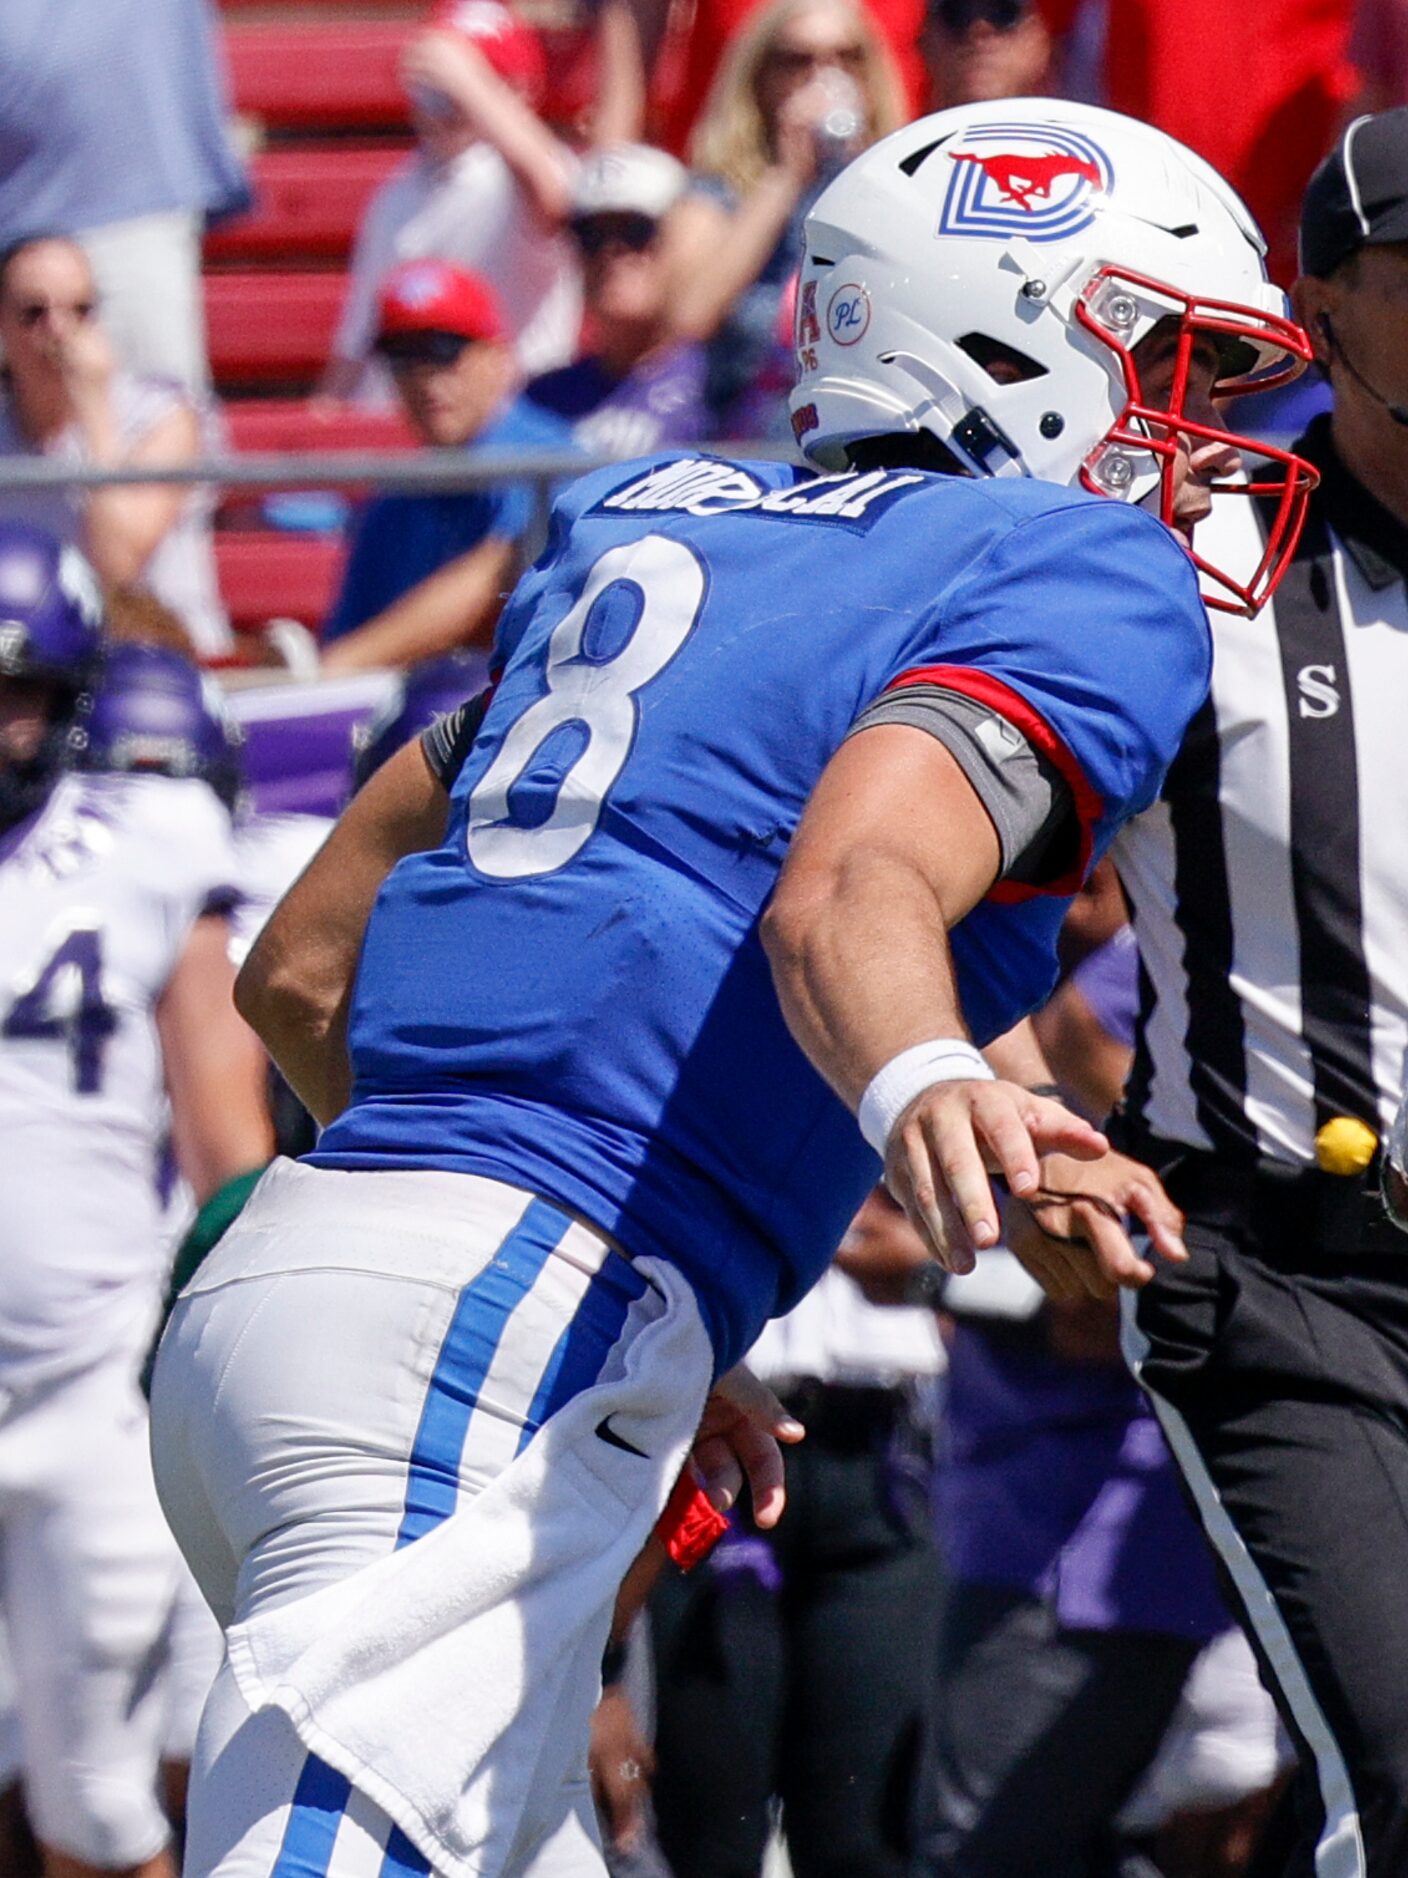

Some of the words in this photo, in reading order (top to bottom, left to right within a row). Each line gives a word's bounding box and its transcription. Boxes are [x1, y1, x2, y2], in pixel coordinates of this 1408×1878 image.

[466, 534, 706, 880] 8
[1296, 664, 1342, 719] S
[1, 929, 120, 1094] 4
